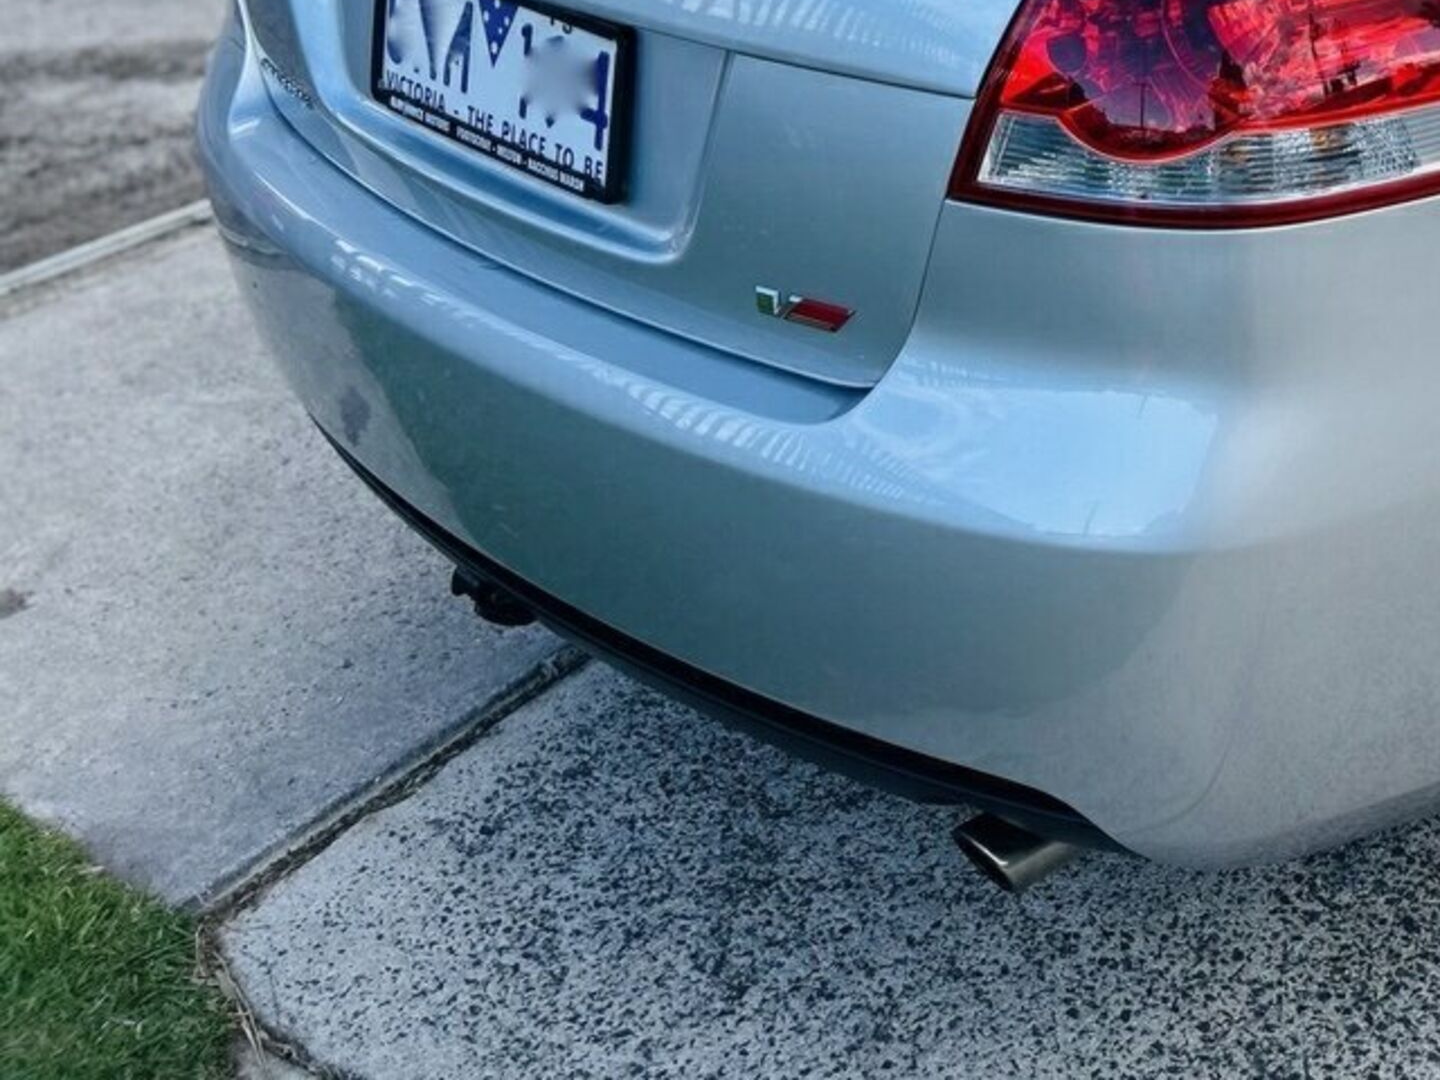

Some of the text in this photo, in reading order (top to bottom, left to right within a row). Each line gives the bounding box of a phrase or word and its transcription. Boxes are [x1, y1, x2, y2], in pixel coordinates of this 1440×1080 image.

[386, 69, 446, 112] VICTORIA
[467, 104, 494, 136] THE
[501, 120, 547, 158] PLACE
[554, 142, 575, 169] TO
[584, 155, 604, 182] BE
